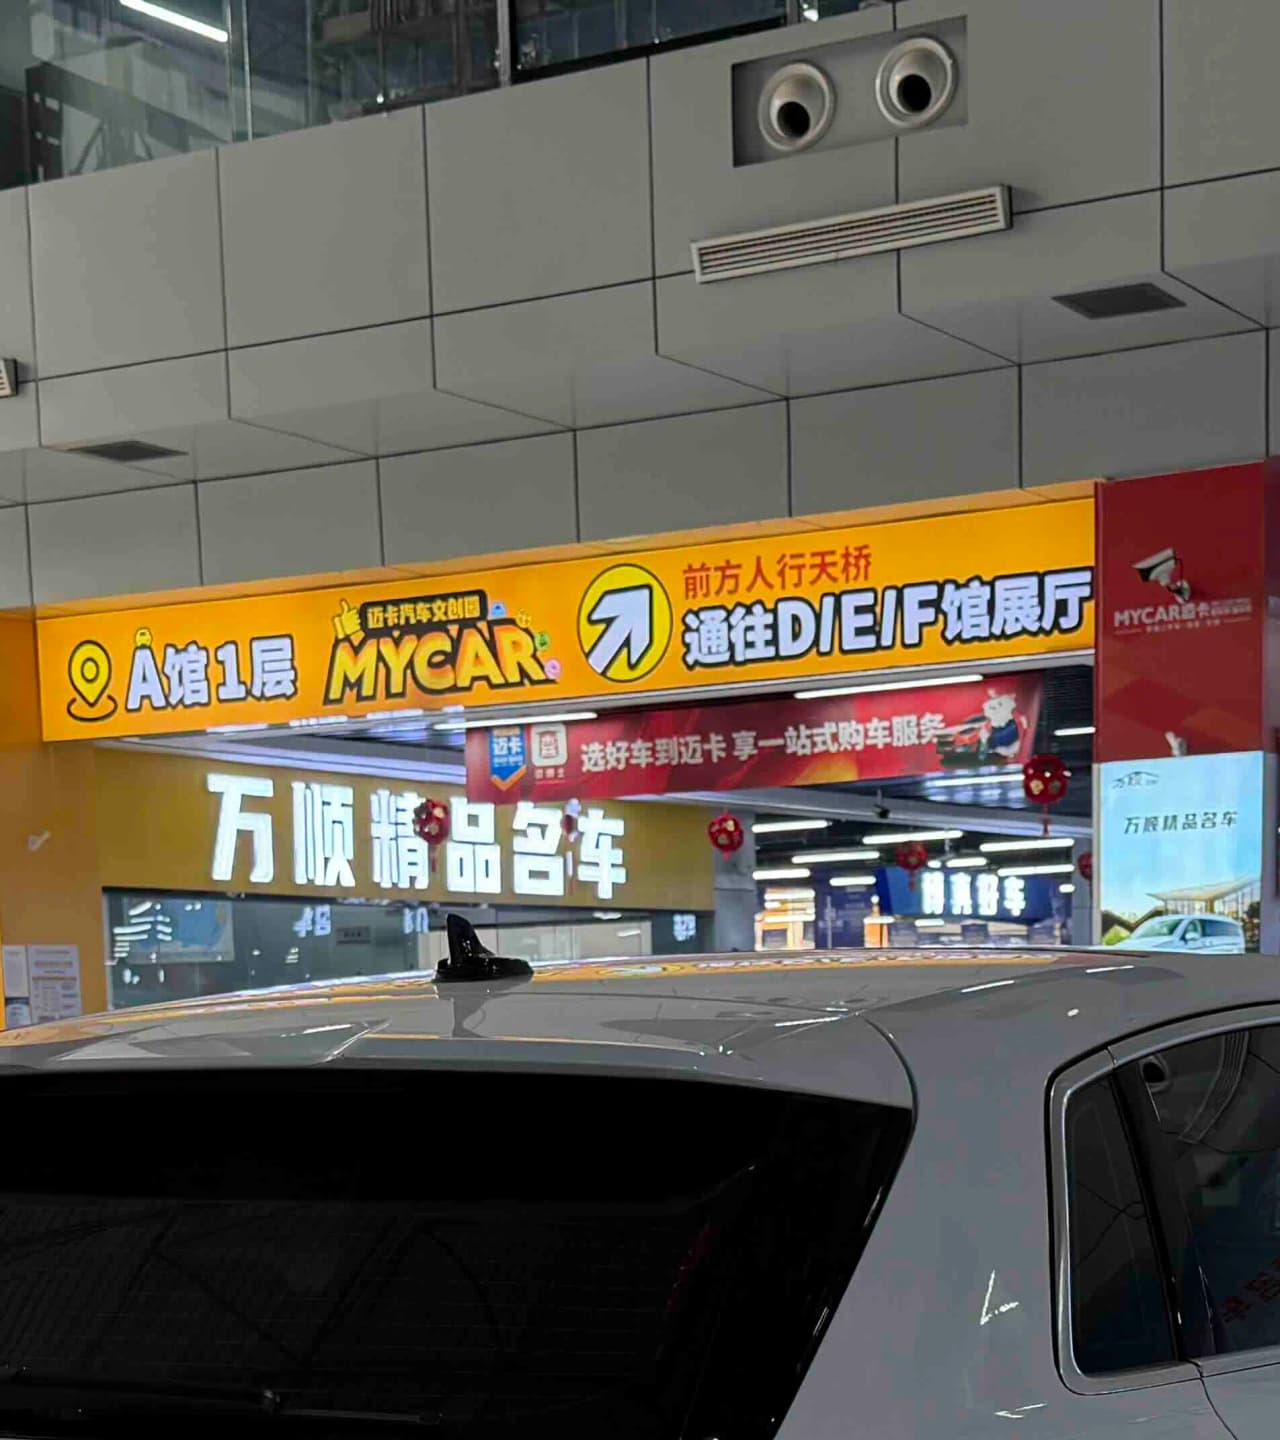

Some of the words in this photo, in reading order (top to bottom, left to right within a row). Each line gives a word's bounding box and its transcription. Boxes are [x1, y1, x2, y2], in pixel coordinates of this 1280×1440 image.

[683, 544, 872, 599] 前方人行天桥
[366, 596, 481, 630] 迈卡汽车文创园
[683, 567, 1093, 669] 通往D/E/F馆展厅
[126, 634, 297, 711] A馆1层
[324, 622, 546, 704] MYCAR
[581, 734, 727, 773] 选好车到迈卡
[732, 712, 946, 763] 享一站式购车服务
[206, 773, 627, 899] 万顺精品名车
[1124, 811, 1237, 835] 万顺精品名车
